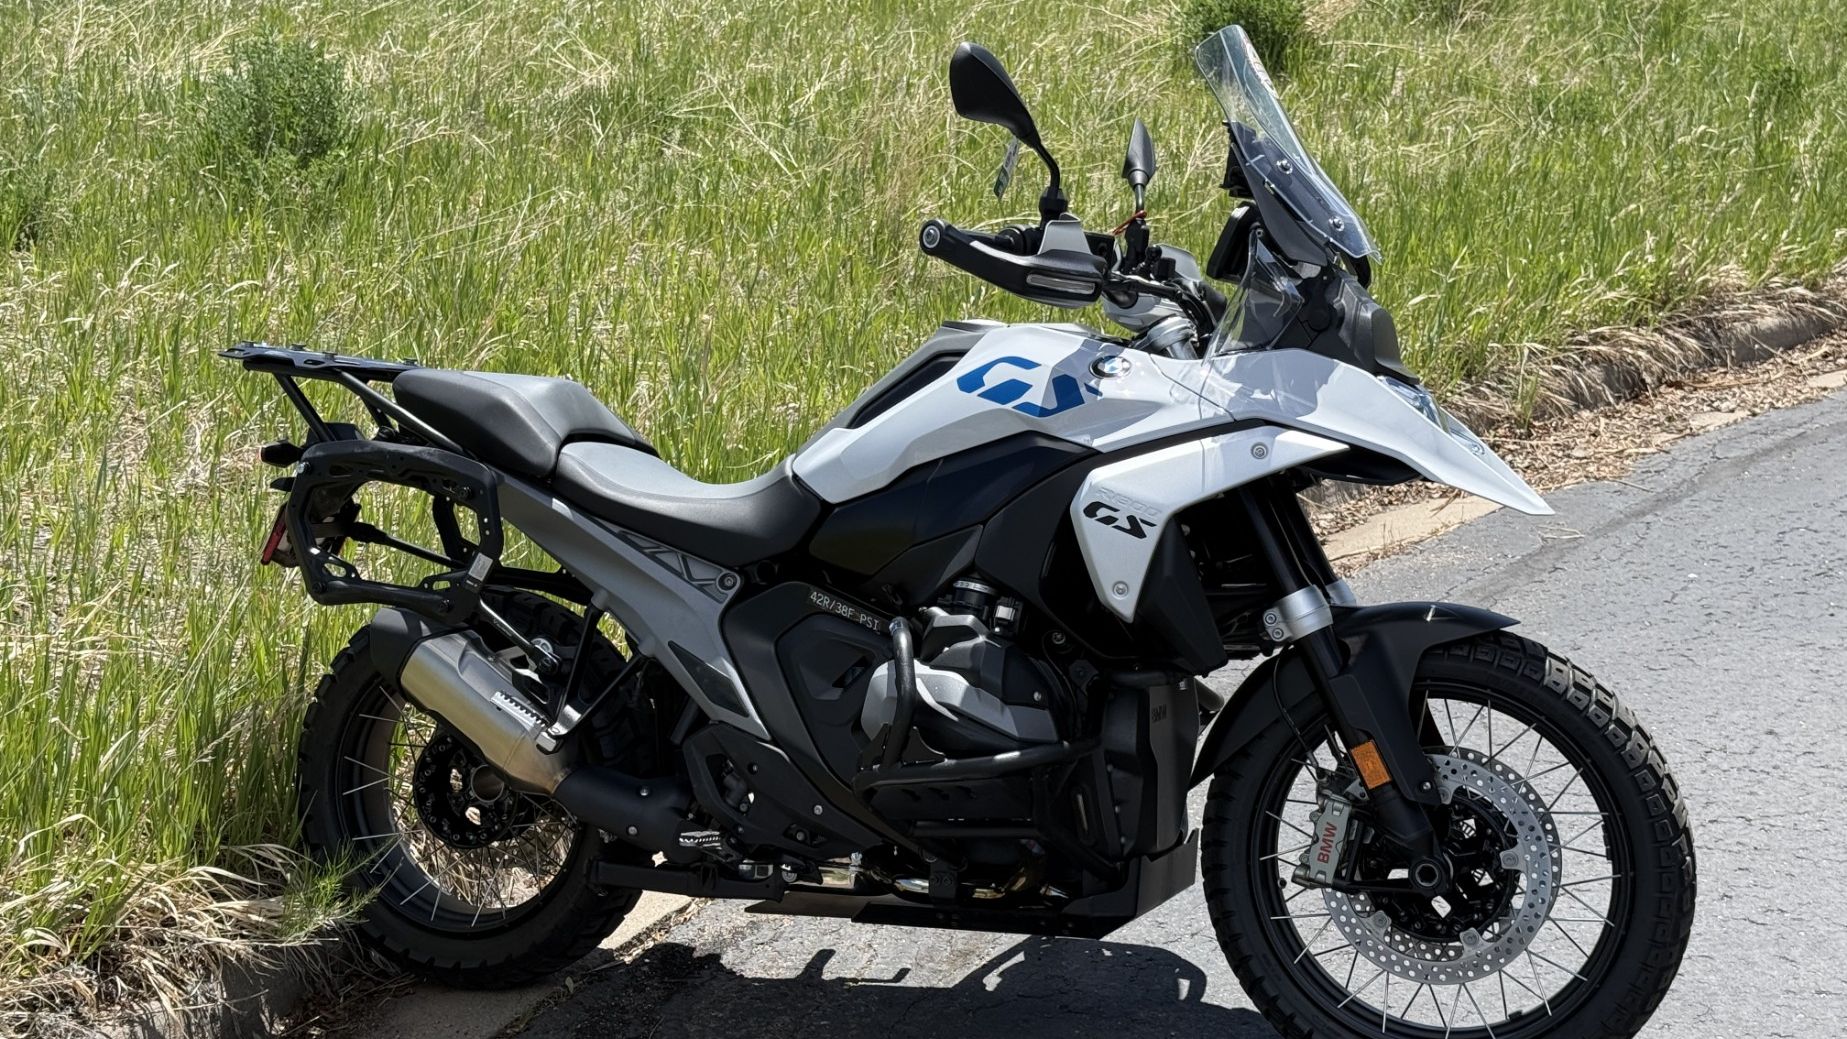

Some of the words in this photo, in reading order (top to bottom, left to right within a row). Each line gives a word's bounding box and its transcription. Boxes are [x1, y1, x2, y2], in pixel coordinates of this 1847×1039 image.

[957, 356, 1103, 418] GS
[1083, 501, 1157, 539] GS
[810, 591, 855, 618] 42R/38F
[859, 613, 880, 631] PSI
[1317, 822, 1338, 864] BMW
